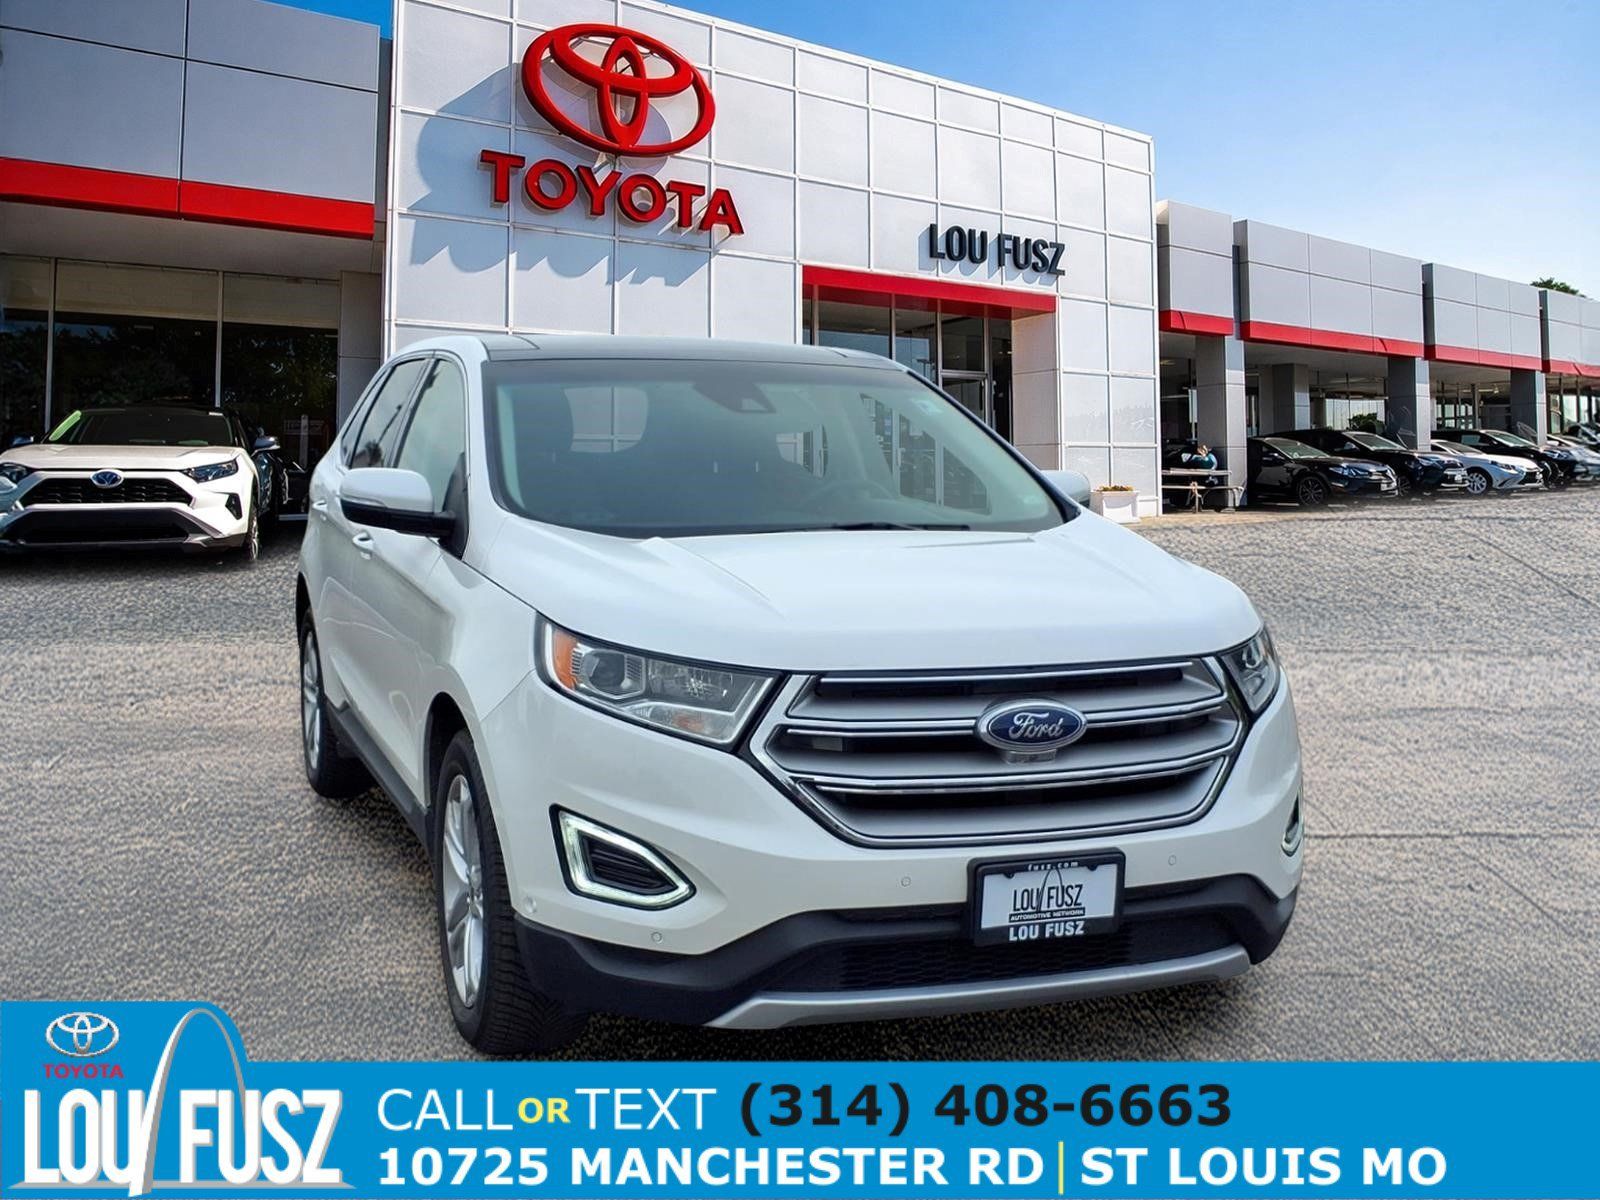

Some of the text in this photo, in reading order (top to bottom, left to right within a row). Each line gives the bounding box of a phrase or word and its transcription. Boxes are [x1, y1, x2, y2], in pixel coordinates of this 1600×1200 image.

[480, 149, 744, 235] TOYOTA
[929, 223, 1066, 276] LOU FUSZ
[1008, 712, 1064, 739] Ford
[1013, 884, 1083, 911] LOU FUSZ
[1010, 908, 1084, 921] AUTOMOTIVE NETWORK
[1009, 920, 1085, 941] LOU FUSZ
